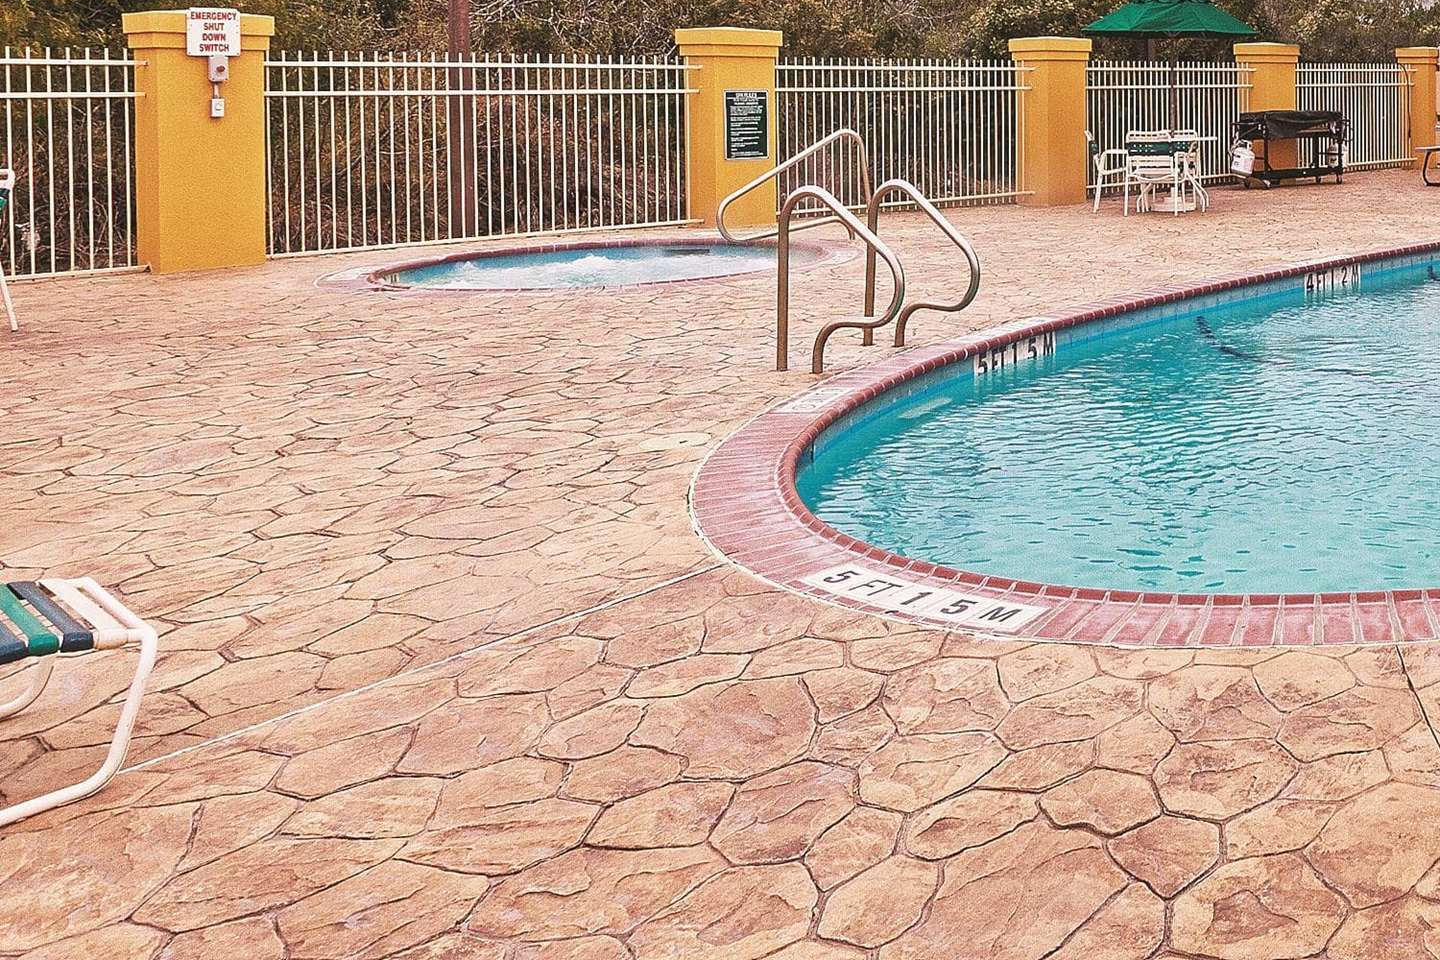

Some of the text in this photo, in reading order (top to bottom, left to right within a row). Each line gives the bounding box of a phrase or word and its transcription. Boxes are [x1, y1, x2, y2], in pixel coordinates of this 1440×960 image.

[191, 11, 237, 20] EMERGENCY
[203, 22, 224, 31] SHUT
[202, 33, 226, 41] DOWN
[200, 43, 229, 52] SWITCH
